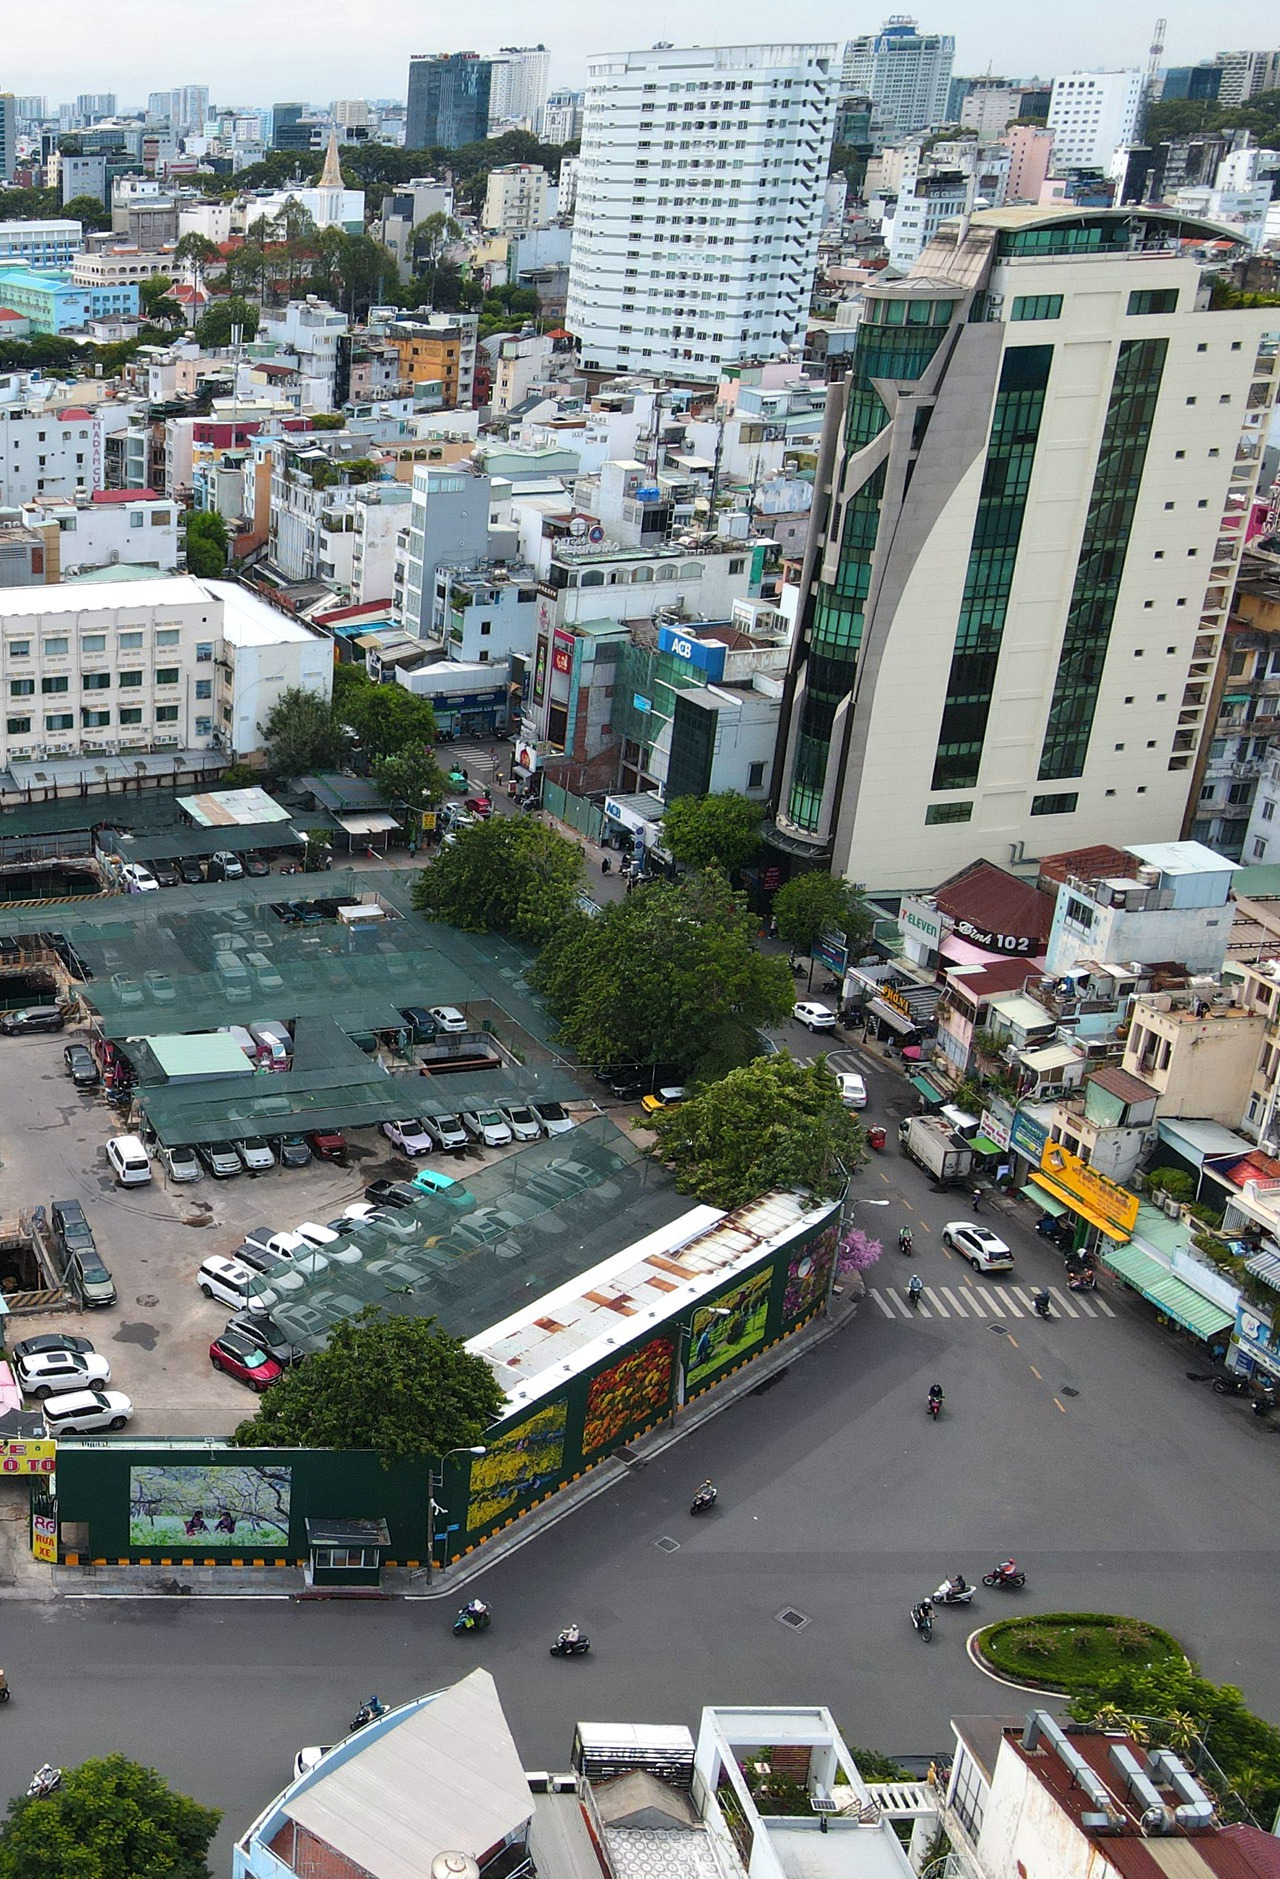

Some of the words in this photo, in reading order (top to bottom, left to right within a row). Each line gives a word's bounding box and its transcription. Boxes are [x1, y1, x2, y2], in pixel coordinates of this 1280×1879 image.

[92, 422, 101, 465] MADAM
[671, 637, 692, 659] ACB
[606, 801, 621, 819] ACB
[996, 934, 1029, 951] 102
[2, 1457, 20, 1473] Ô
[26, 1457, 56, 1473] TÔ
[35, 1516, 56, 1534] 86
[39, 1546, 51, 1558] XE
